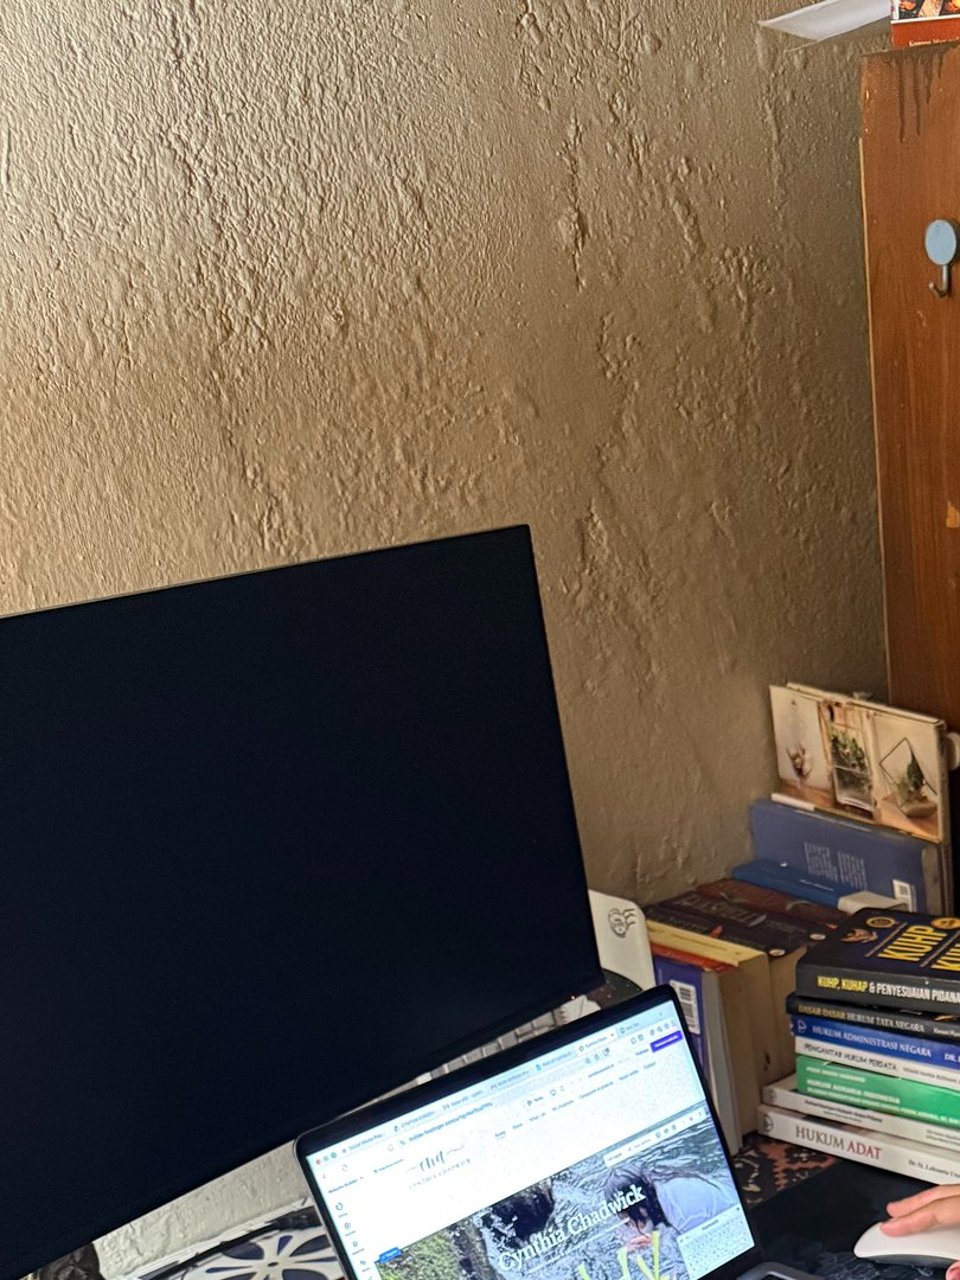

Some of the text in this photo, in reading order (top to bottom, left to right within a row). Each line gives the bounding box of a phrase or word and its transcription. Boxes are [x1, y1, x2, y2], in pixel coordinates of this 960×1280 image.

[877, 925, 948, 961] KUHP
[841, 978, 868, 992] KUHAP
[876, 982, 931, 1000] PENYESUAIAN
[812, 1025, 841, 1039] HUKUM
[843, 1032, 898, 1050] ADMINISTRASI
[899, 1043, 932, 1058] NEGARA
[895, 1019, 925, 1032] NEGARA
[795, 1126, 882, 1160] HUKUM ADAT
[498, 1184, 646, 1271] Cynthia Chadwick
